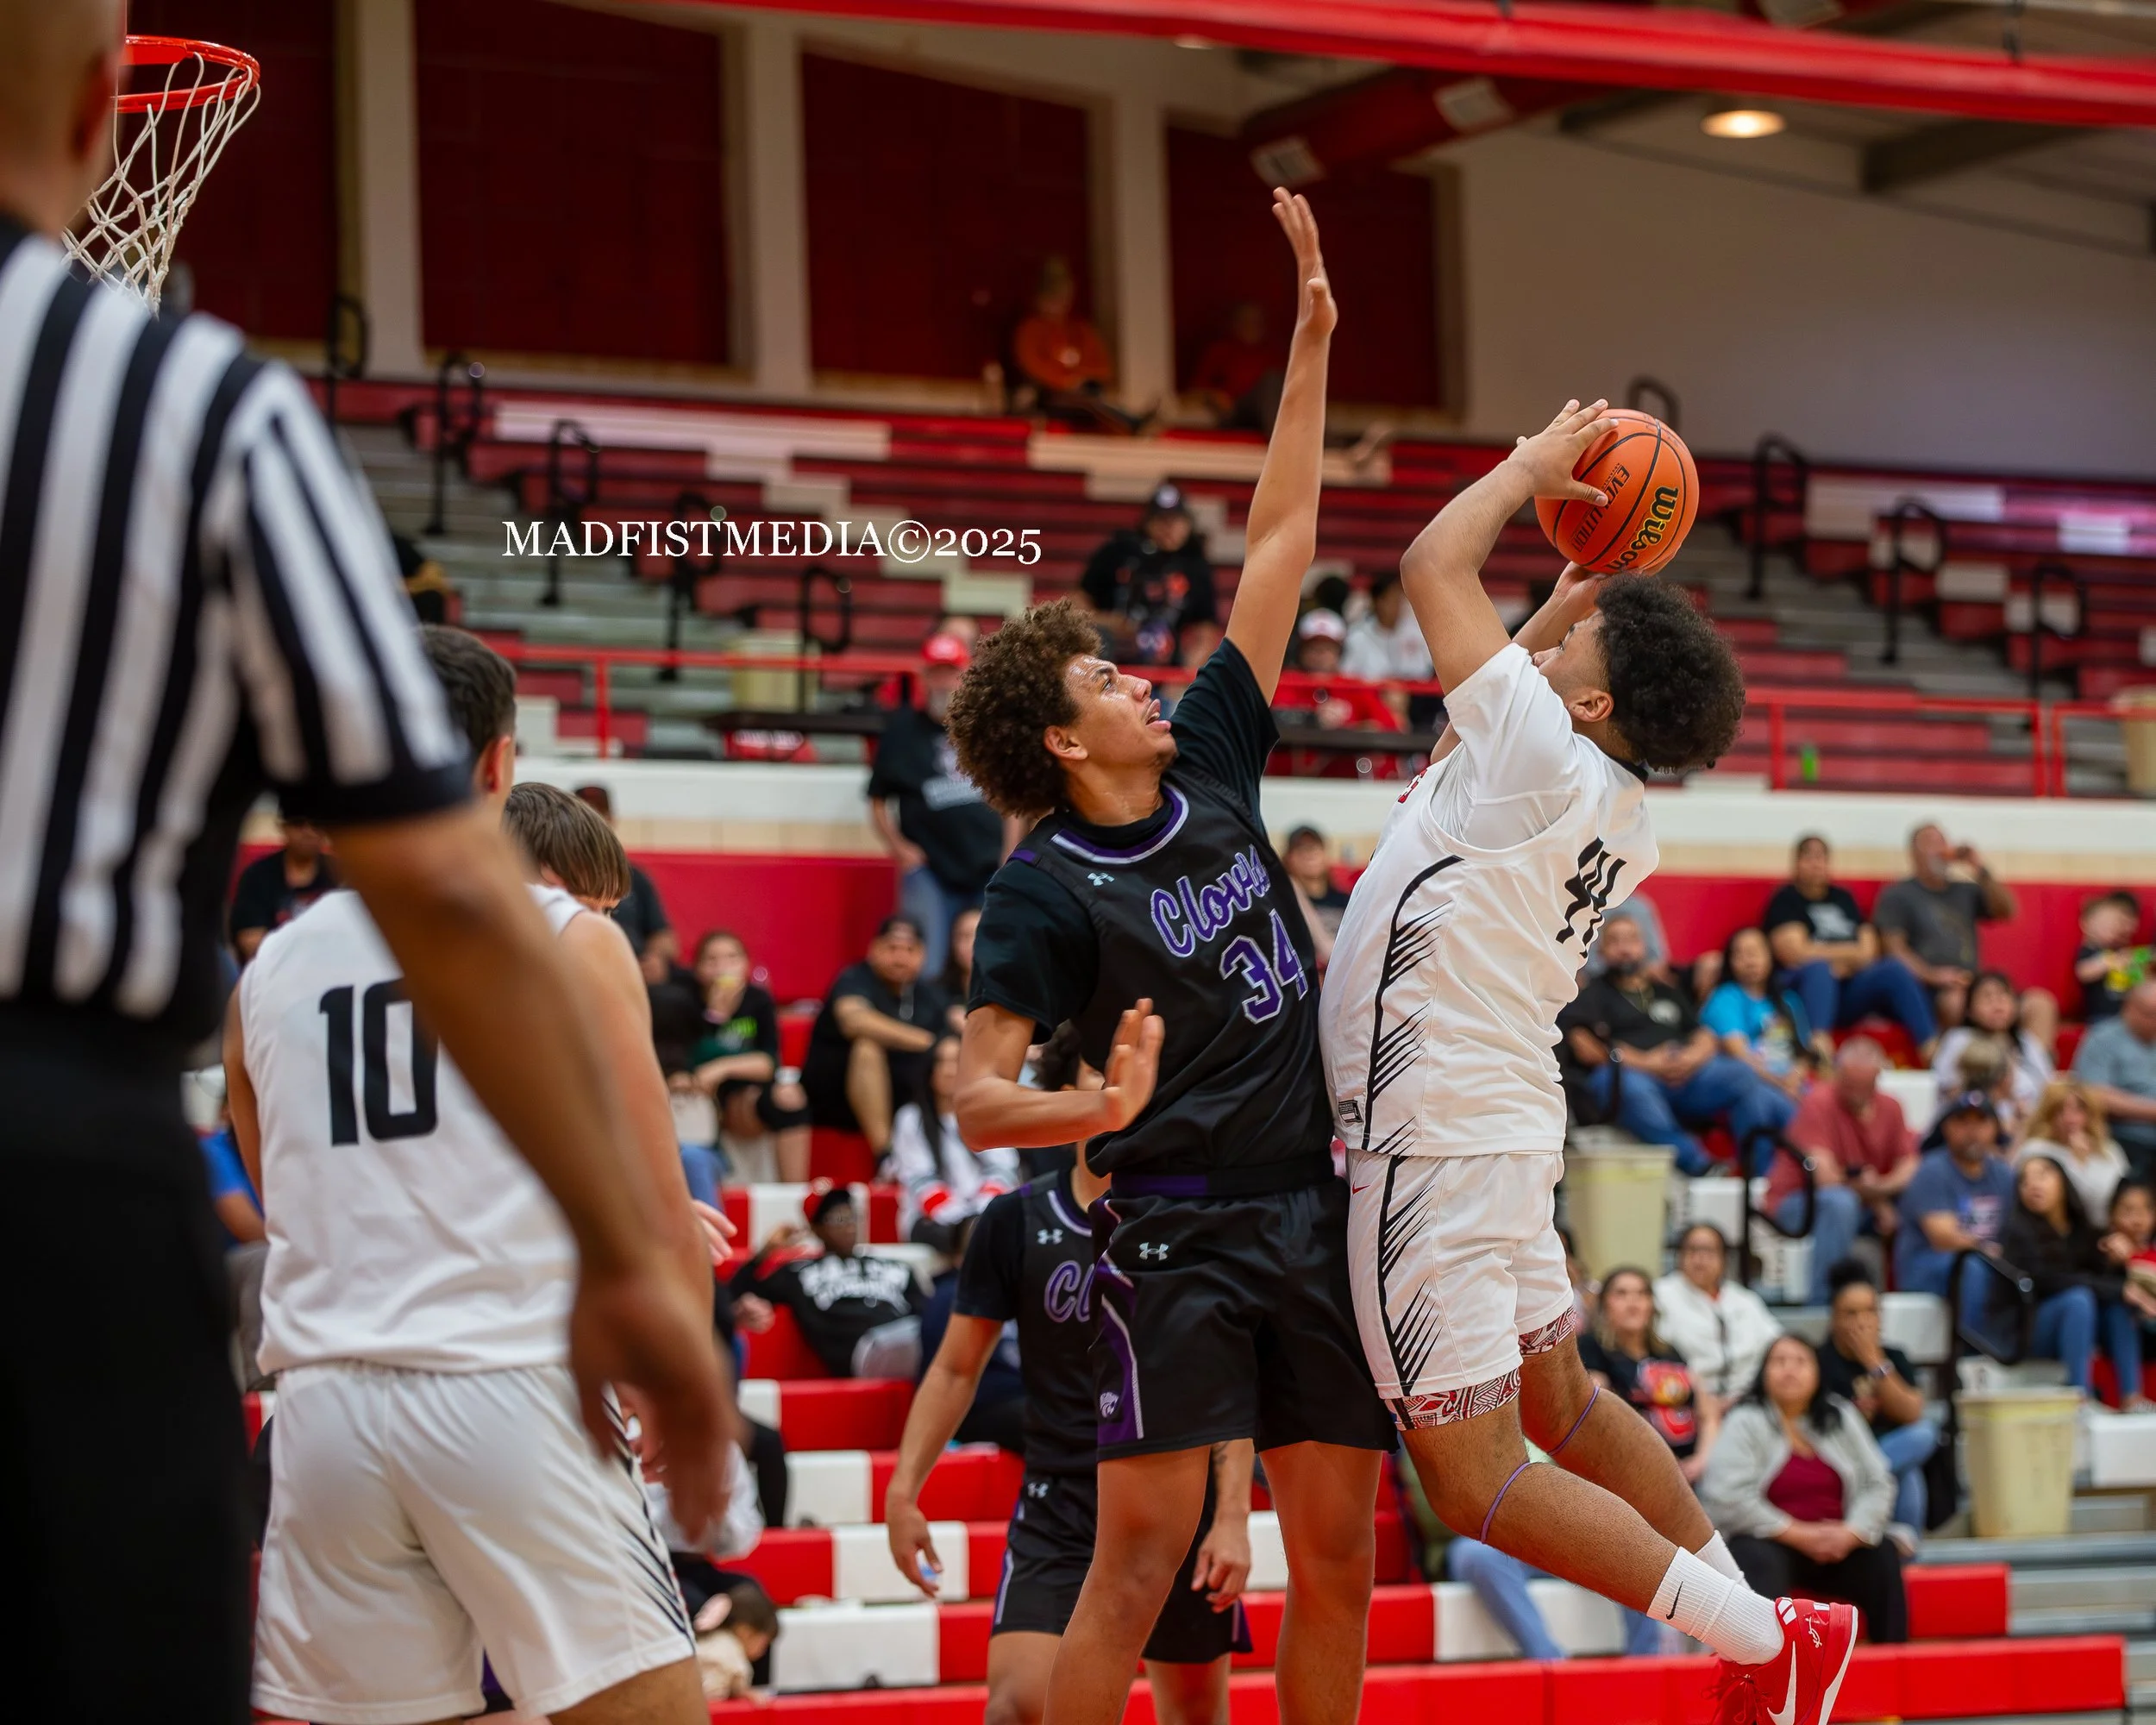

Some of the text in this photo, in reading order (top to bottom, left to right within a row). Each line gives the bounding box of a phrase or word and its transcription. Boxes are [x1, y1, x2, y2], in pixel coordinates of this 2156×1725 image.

[1606, 485, 1680, 571] Wilson
[1219, 907, 1309, 1025] 34
[318, 976, 441, 1147] 10
